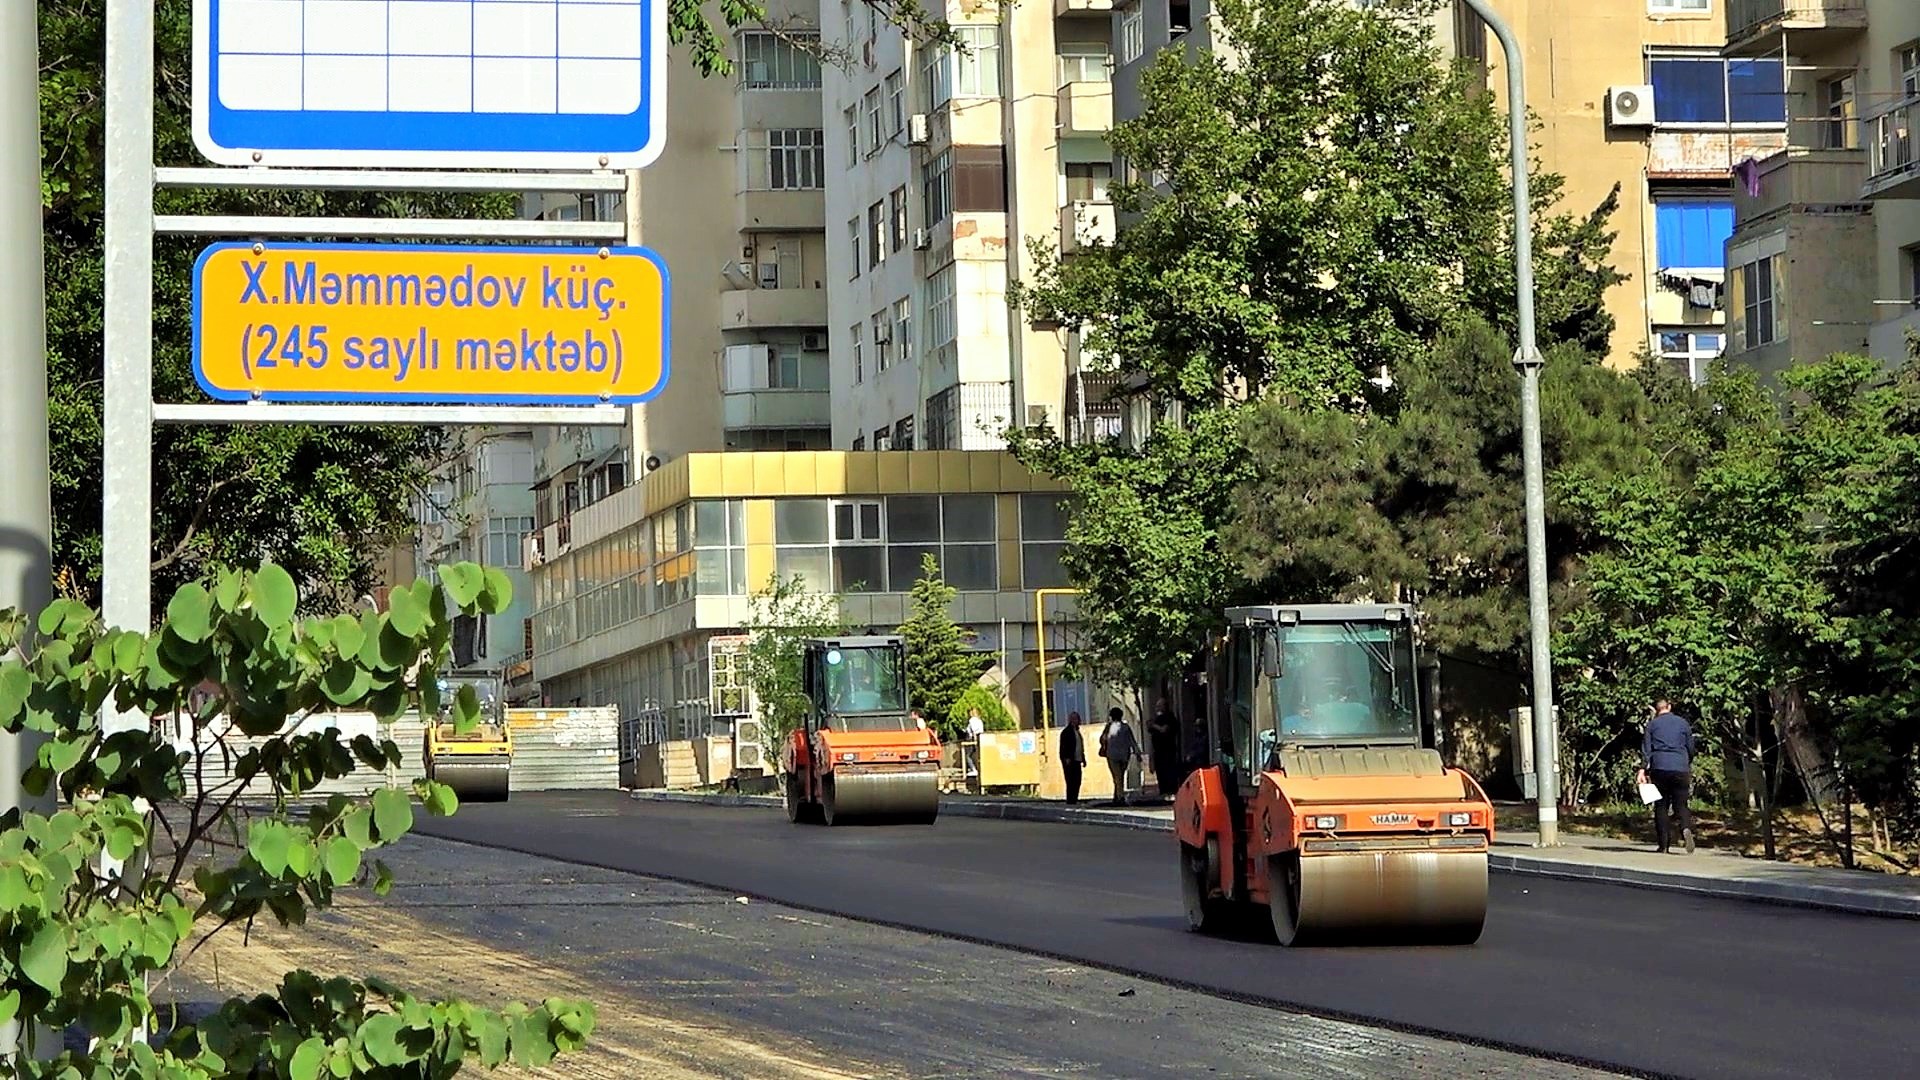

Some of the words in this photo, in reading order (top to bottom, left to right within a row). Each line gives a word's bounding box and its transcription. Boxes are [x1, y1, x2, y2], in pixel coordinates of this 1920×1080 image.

[241, 261, 526, 309] X.Məmmədov
[542, 265, 626, 320] küç.
[241, 324, 329, 380] (245
[343, 328, 439, 382] saylı
[456, 329, 622, 384] məktəb)
[1376, 814, 1410, 824] HAMM
